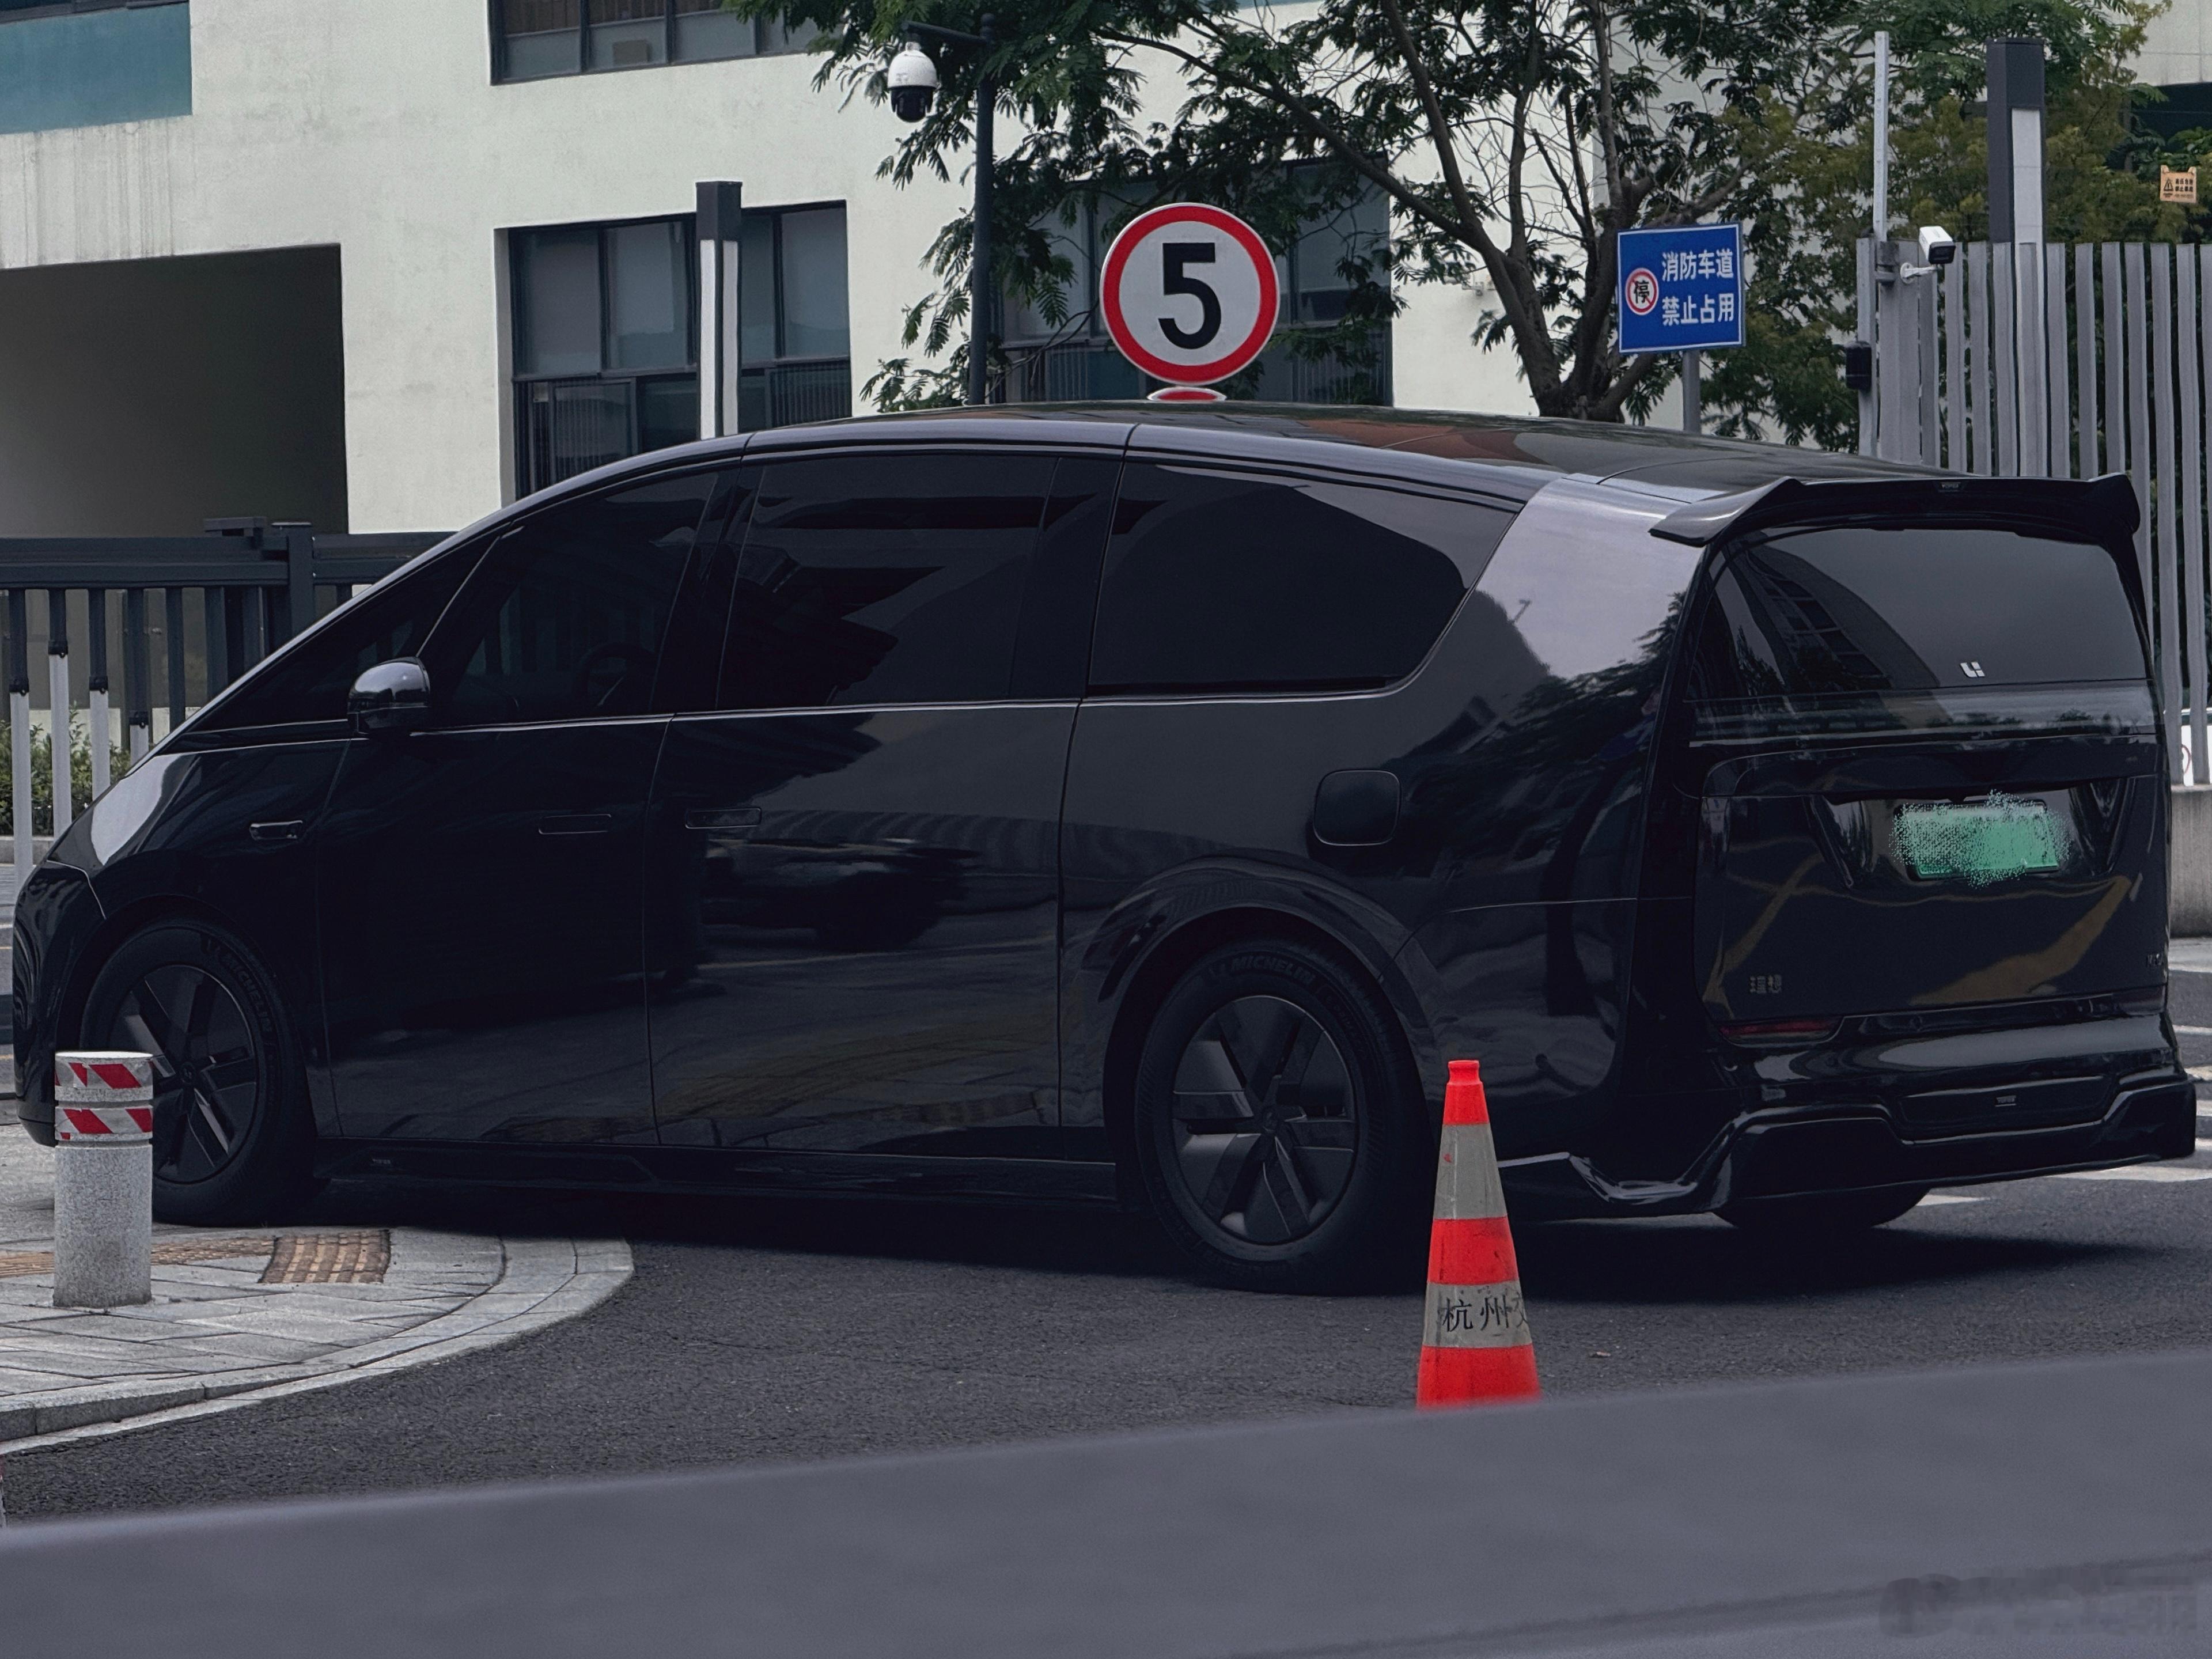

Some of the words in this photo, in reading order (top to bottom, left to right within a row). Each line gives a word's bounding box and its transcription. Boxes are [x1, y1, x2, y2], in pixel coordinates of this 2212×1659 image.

[1662, 248, 1734, 282] 消防车道
[1158, 243, 1221, 349] 5
[1634, 280, 1650, 304] 停
[1662, 293, 1734, 327] 禁止占用
